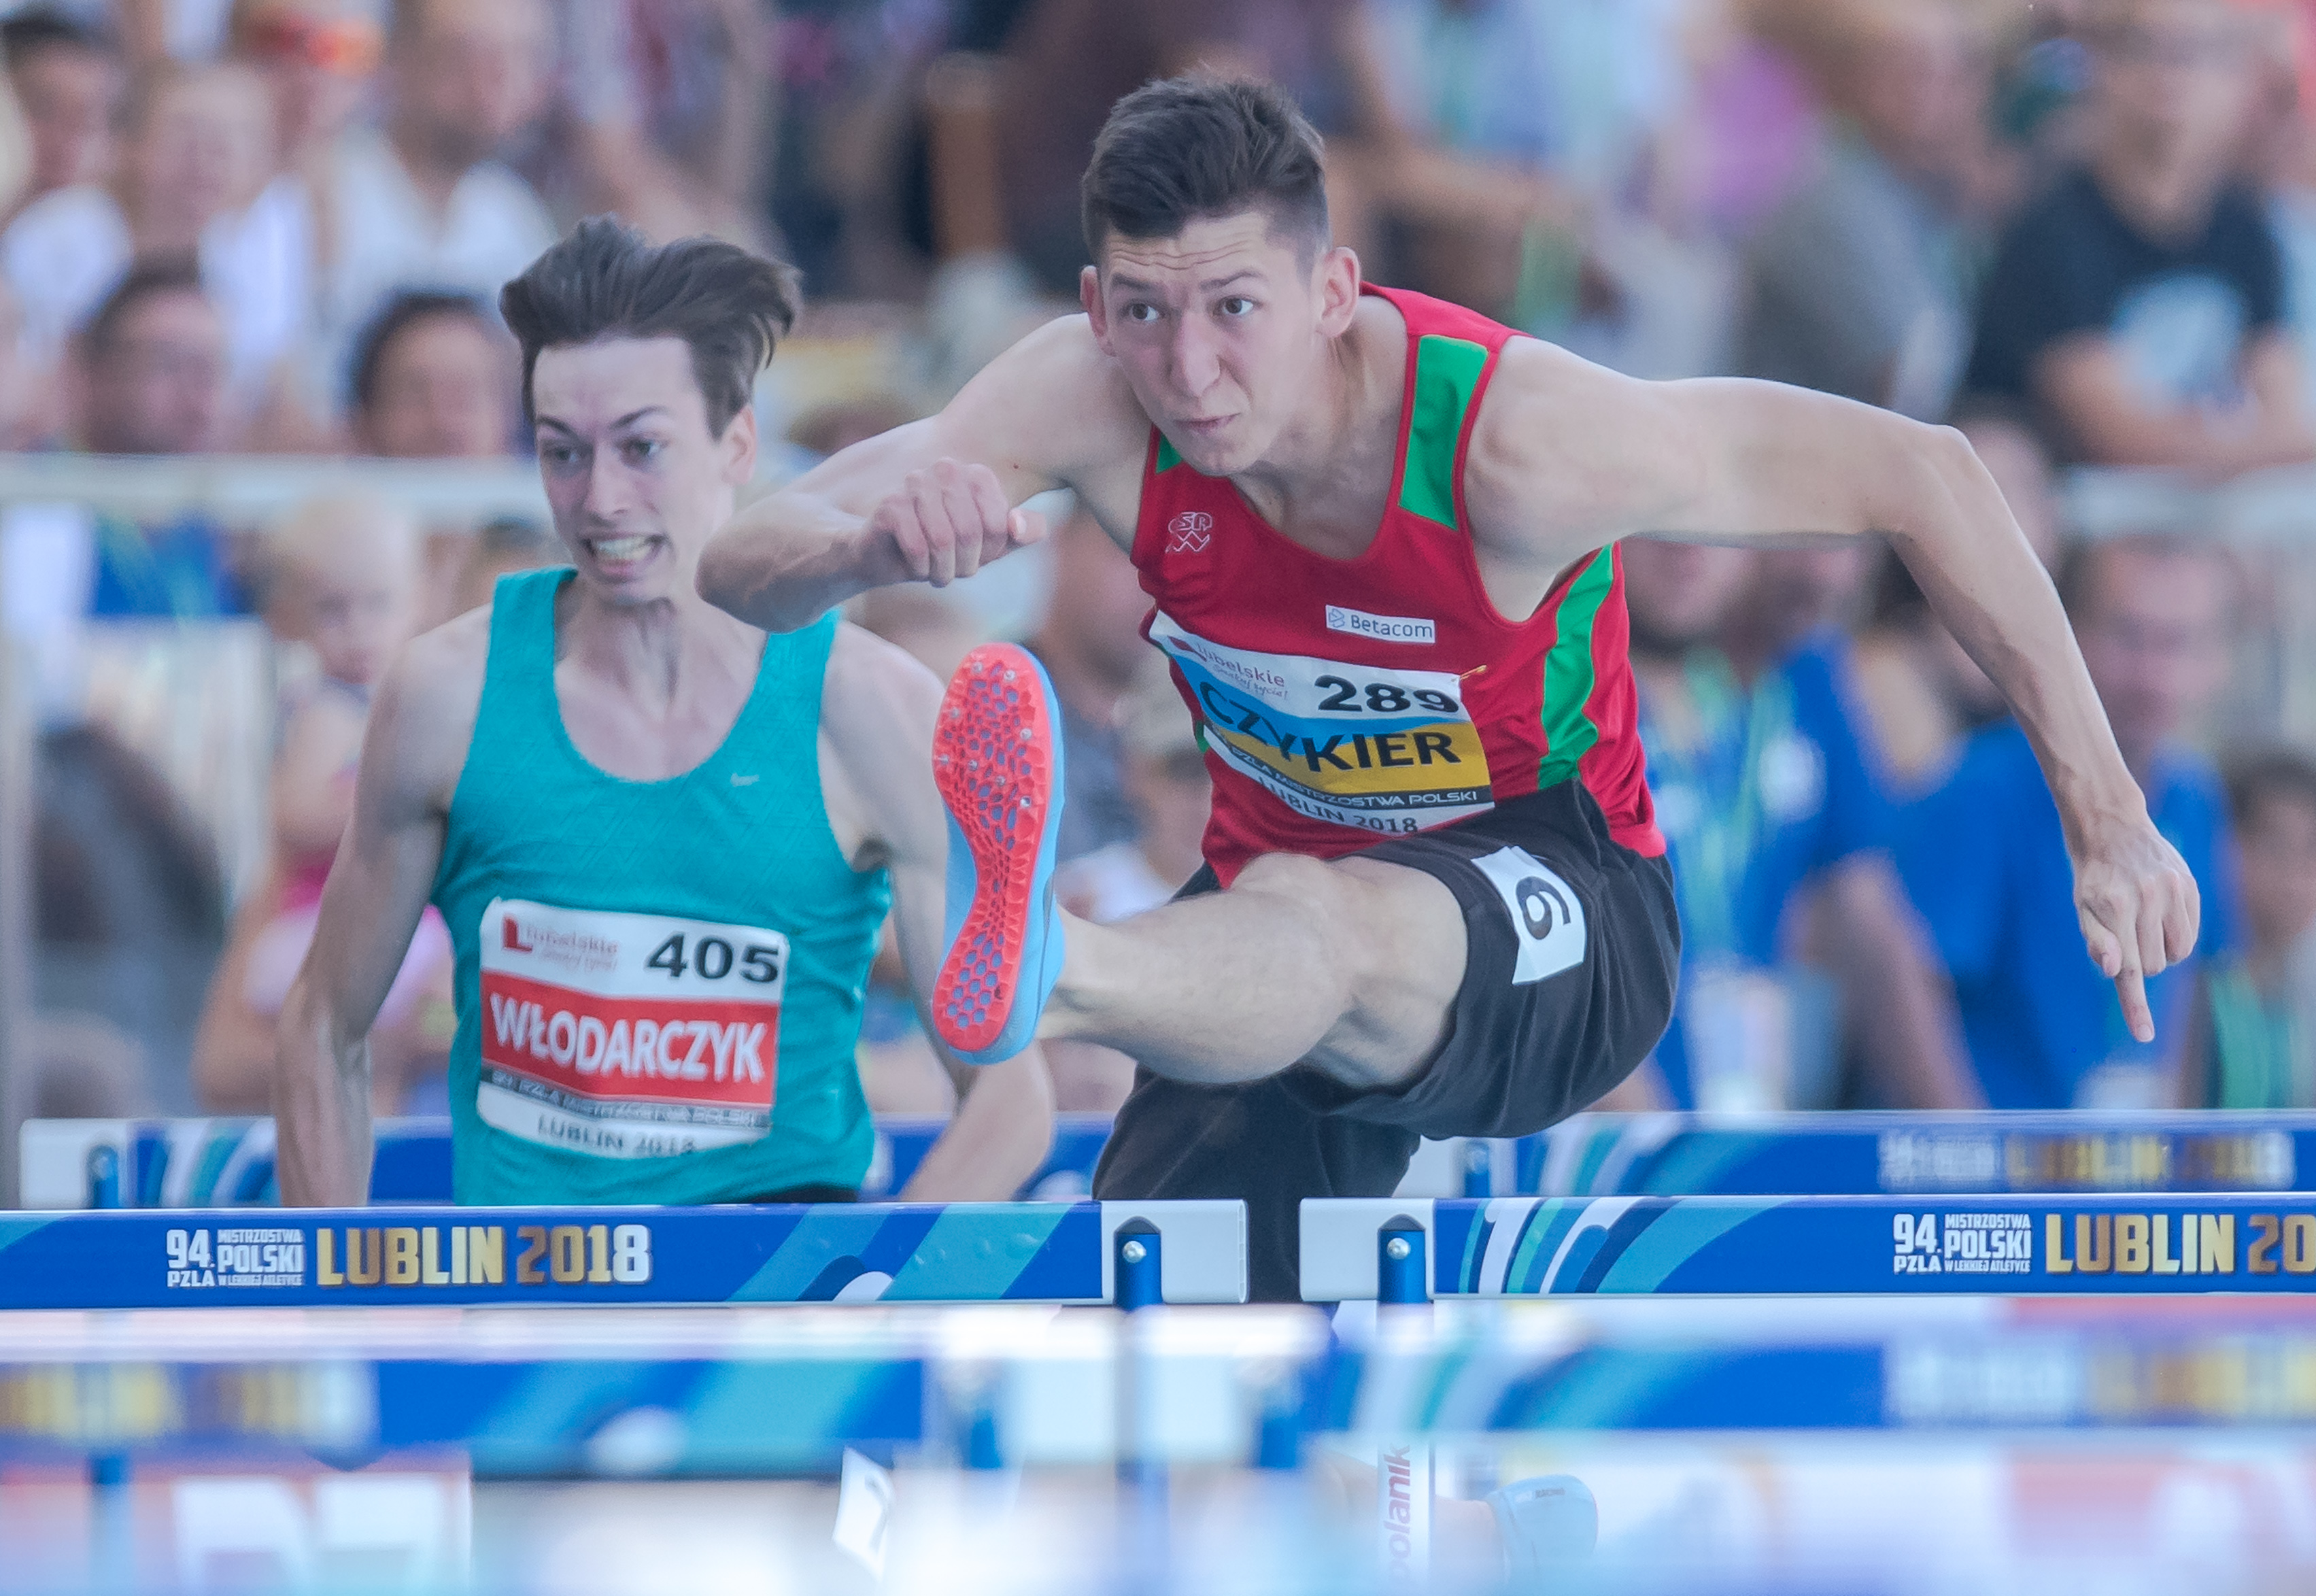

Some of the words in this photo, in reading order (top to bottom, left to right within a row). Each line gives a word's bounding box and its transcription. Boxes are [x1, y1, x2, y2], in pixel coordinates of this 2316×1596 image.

[1350, 614, 1433, 639] Betacom
[1314, 674, 1459, 713] 289
[1199, 681, 1462, 772] CZYKIER
[1258, 775, 1345, 823] LUBLIN
[1353, 815, 1418, 833] 2018
[1409, 791, 1478, 805] POLSKI
[1515, 875, 1571, 940] 6
[646, 932, 779, 983] 405
[490, 991, 767, 1084] WŁODARCZYK
[1944, 1213, 2032, 1229] MISTRZOSTWA
[217, 1229, 304, 1244] MISTRZOSTWA
[1943, 1229, 2032, 1259] POLSKI
[2045, 1215, 2236, 1274] LUBLIN
[217, 1244, 304, 1273] POLSKI
[316, 1226, 503, 1285] LUBLIN
[516, 1225, 651, 1284] 2018
[1893, 1255, 1943, 1274] PZLA
[1944, 1259, 1954, 1272] W
[1954, 1259, 1990, 1272] LEKKIEJ
[167, 1270, 216, 1287] PZLA
